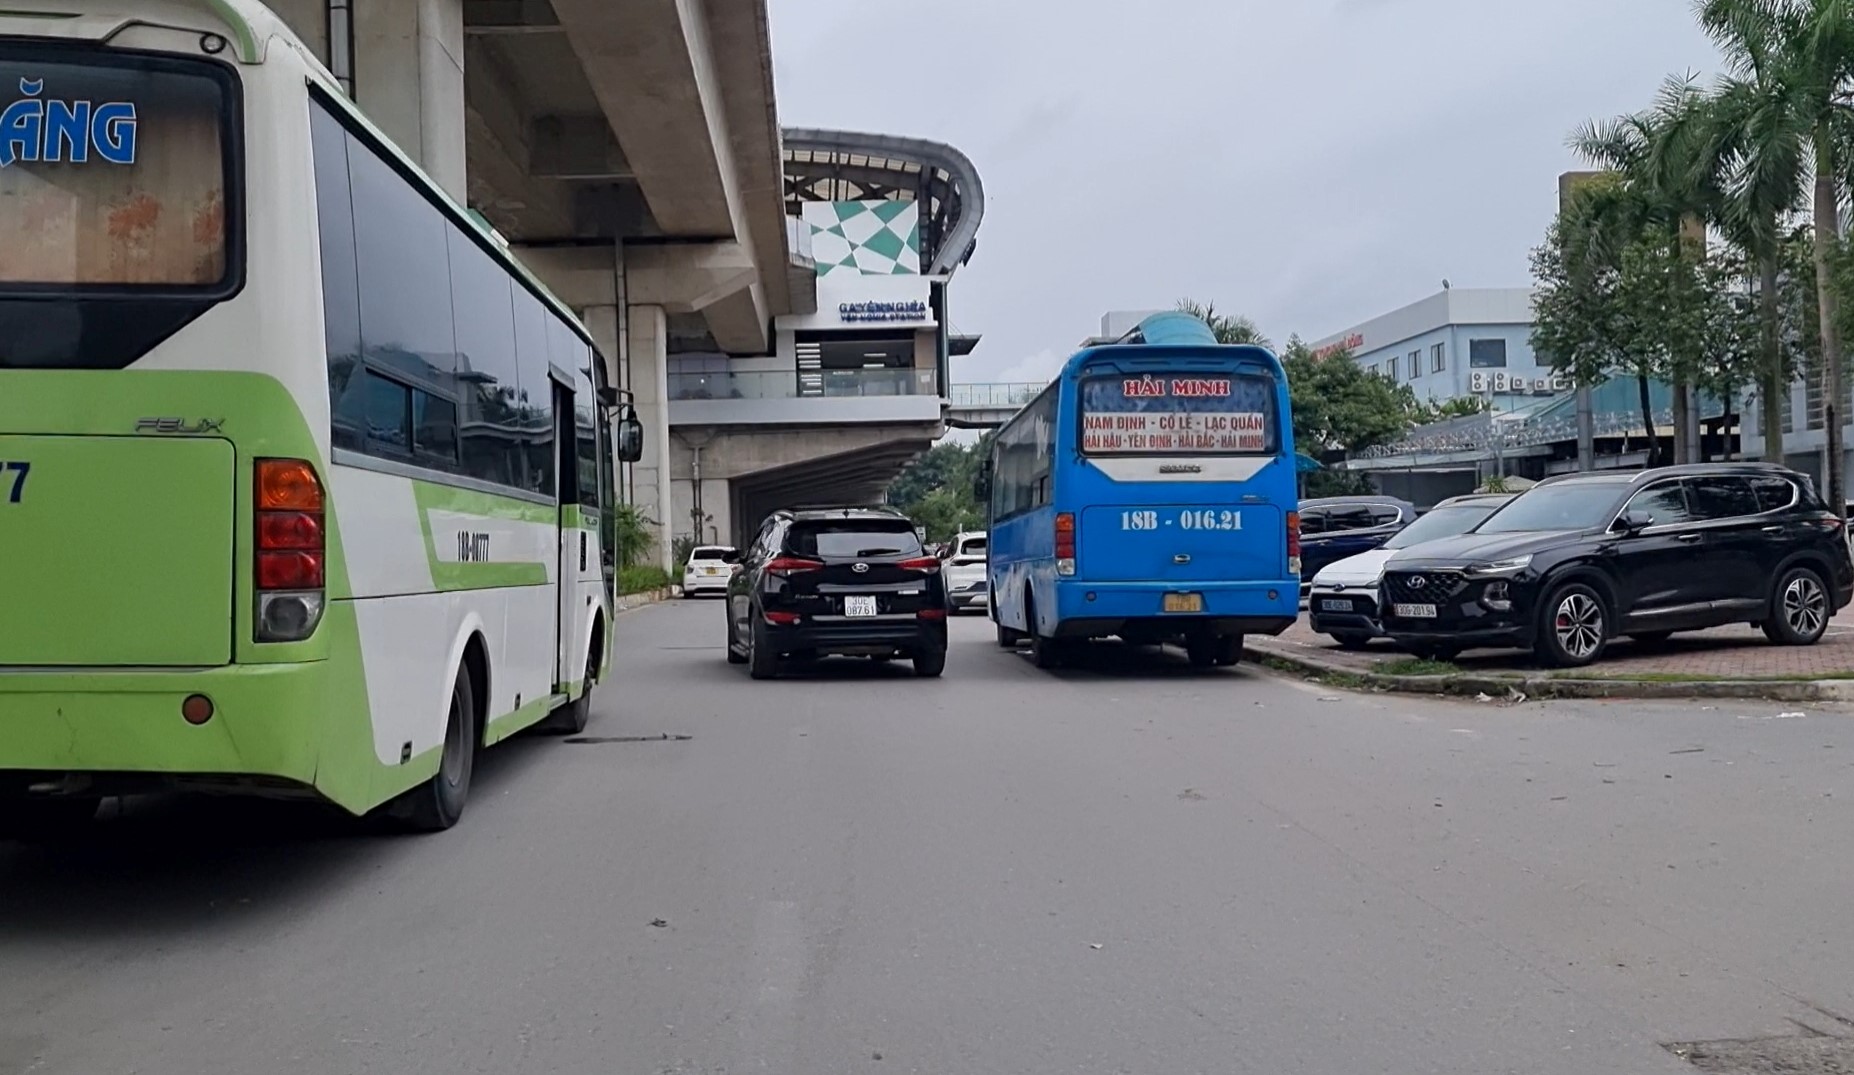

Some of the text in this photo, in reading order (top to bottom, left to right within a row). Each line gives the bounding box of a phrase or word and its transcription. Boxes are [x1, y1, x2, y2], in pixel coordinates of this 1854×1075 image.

[1123, 374, 1231, 397] HẢI MINH
[1084, 416, 1114, 430] NAM
[1117, 416, 1146, 432] ĐỊNH
[1239, 434, 1263, 449] MINH
[0, 461, 31, 503] 7
[1121, 510, 1158, 530] 18B
[1180, 510, 1243, 530] 016.21
